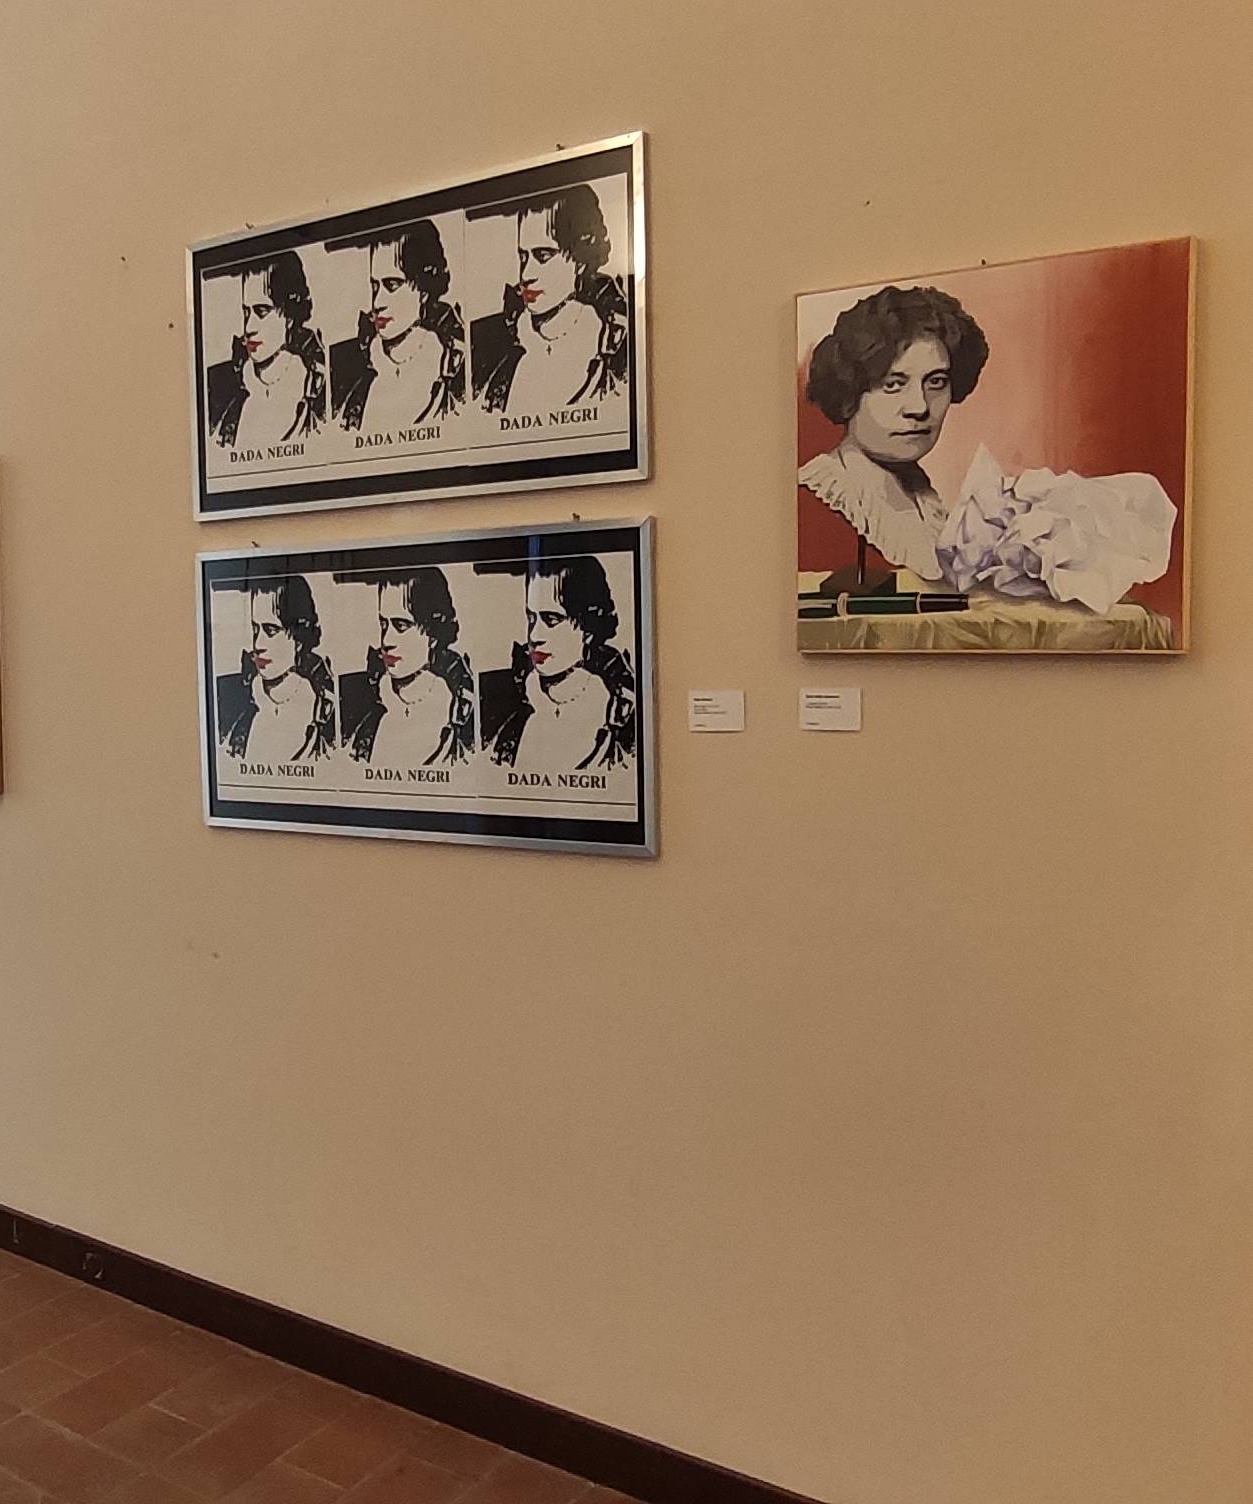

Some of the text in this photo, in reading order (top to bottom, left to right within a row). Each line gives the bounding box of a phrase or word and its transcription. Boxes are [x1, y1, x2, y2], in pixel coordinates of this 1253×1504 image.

[499, 407, 599, 431] DADA NEGRI
[354, 426, 441, 449] DADA NEGRI
[229, 443, 305, 463] DADA NEGRI
[239, 763, 315, 778] DADA NEGRI
[365, 767, 450, 783] DADA NEGRI
[507, 773, 607, 789] DADA NEGRI
